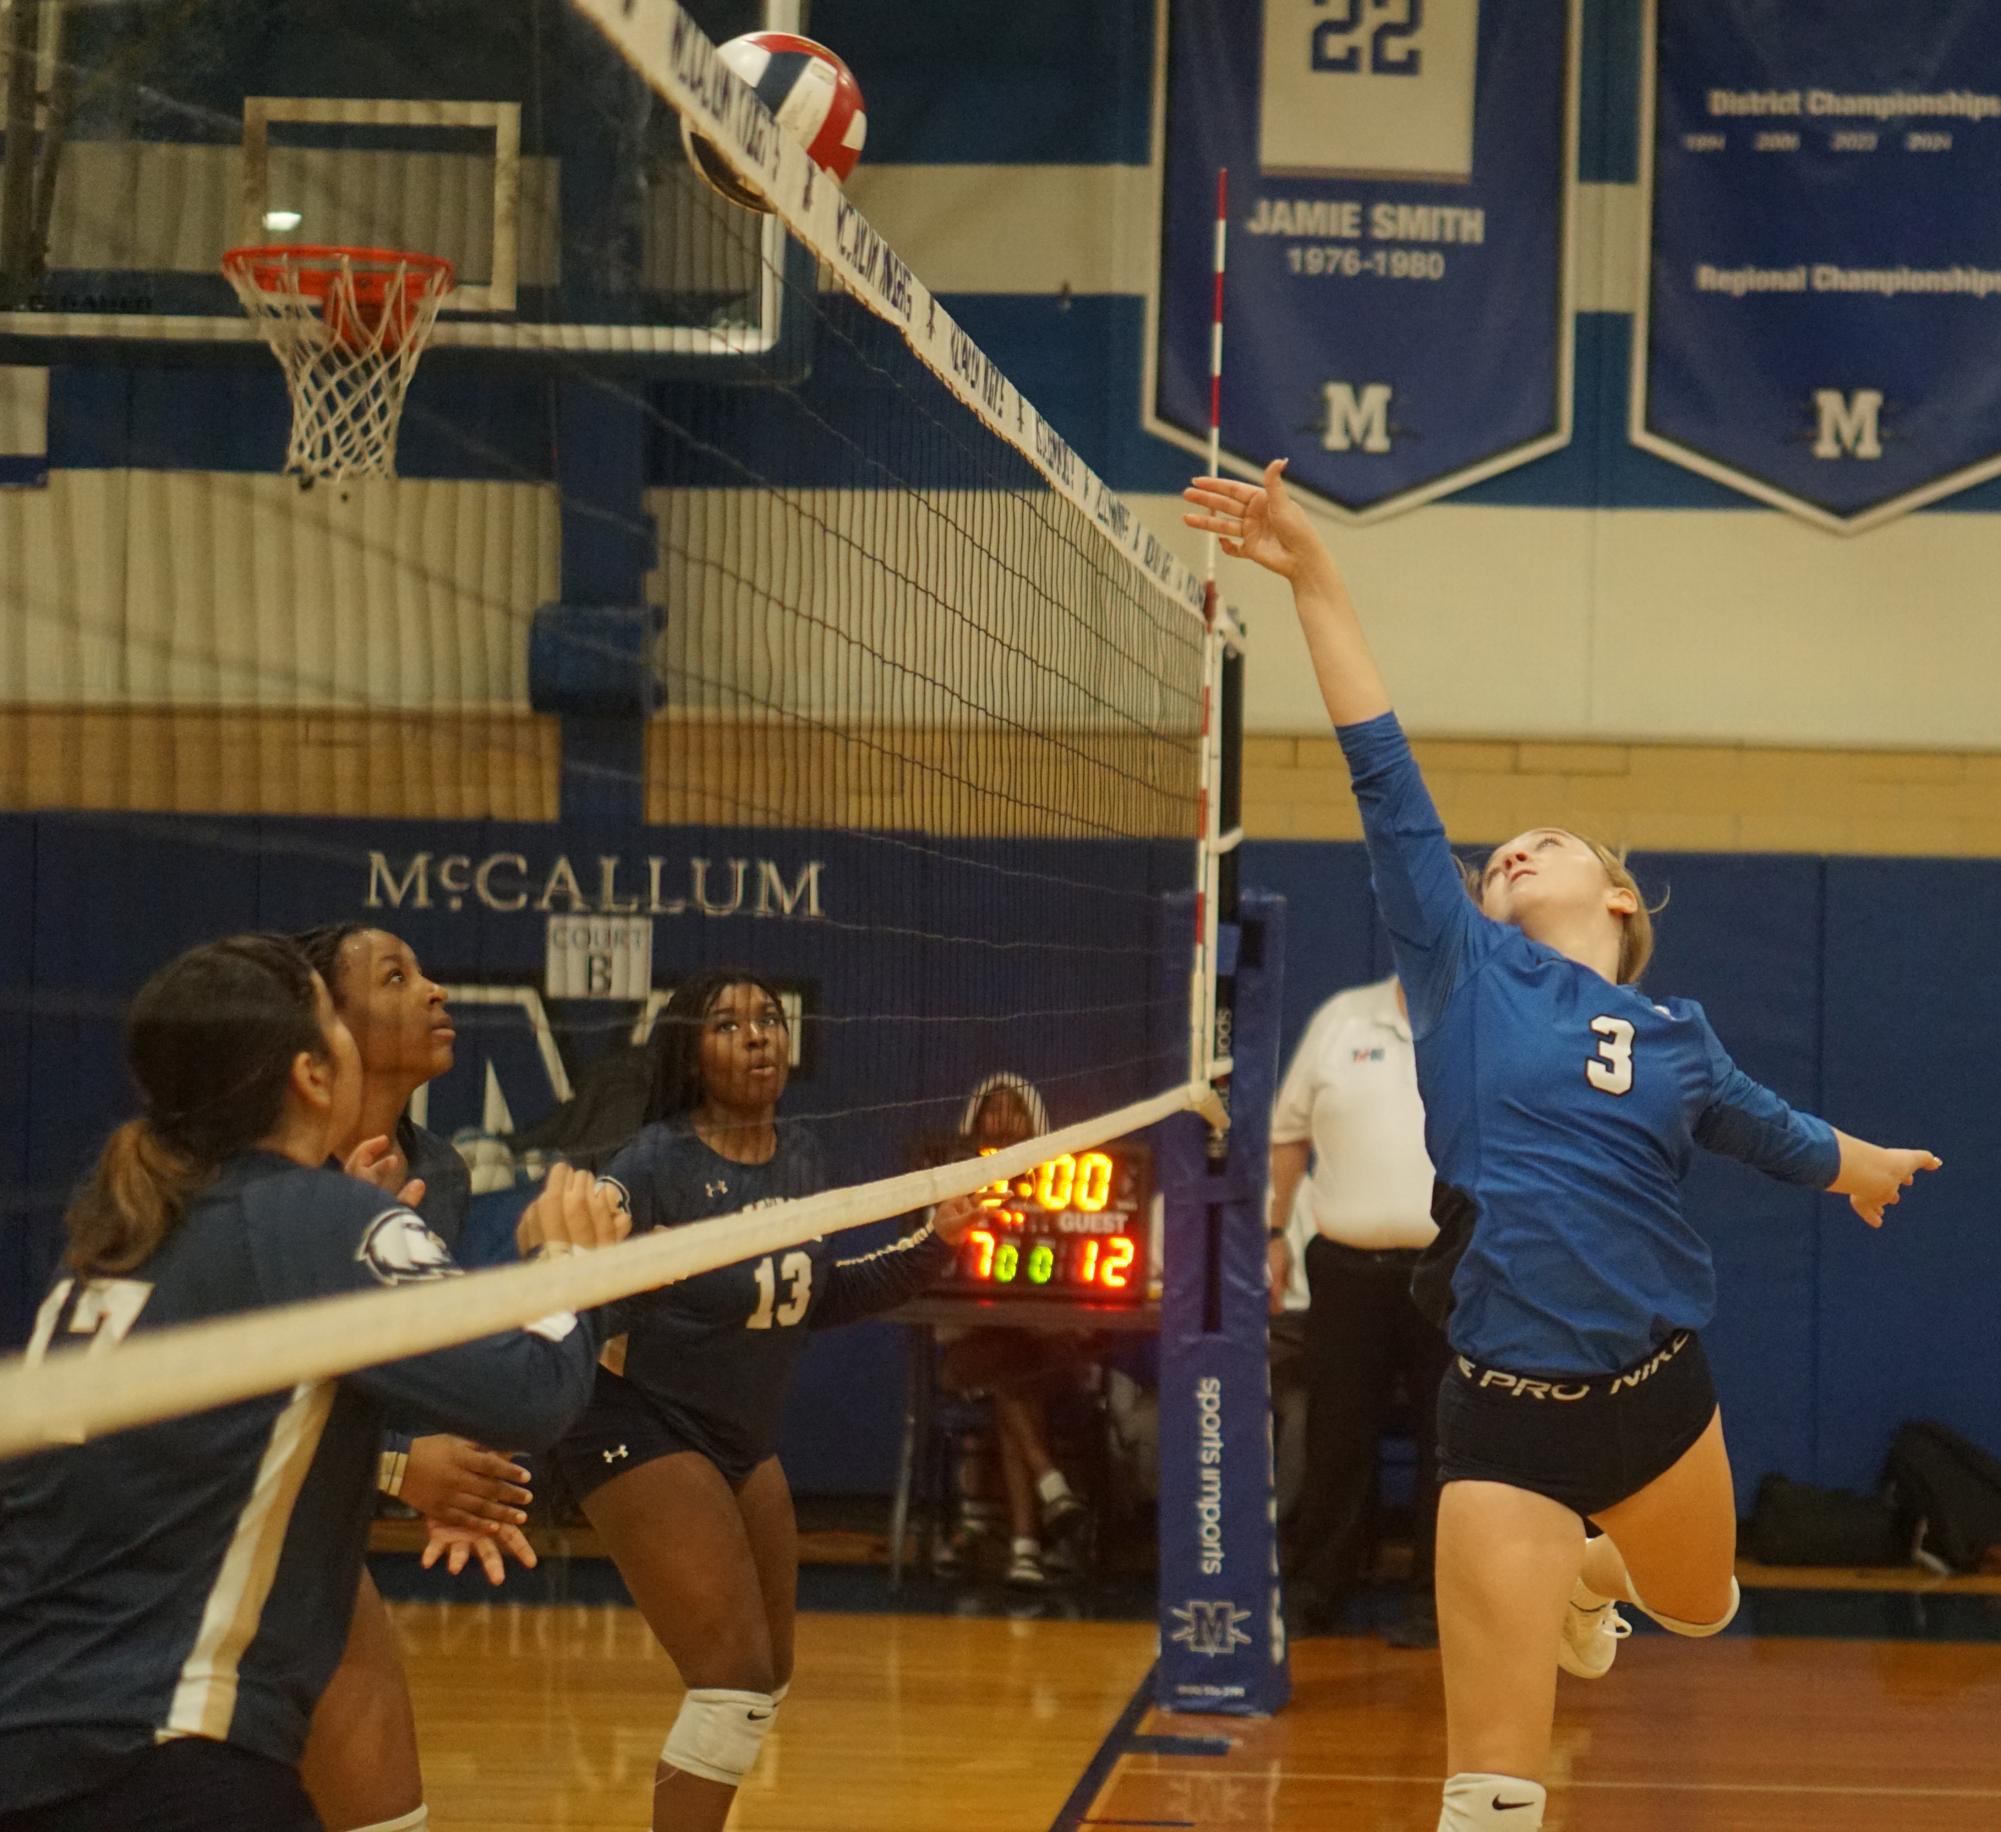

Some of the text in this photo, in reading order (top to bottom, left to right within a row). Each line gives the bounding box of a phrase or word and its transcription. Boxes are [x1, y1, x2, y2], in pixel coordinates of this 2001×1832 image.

[1312, 0, 1423, 76] 22
[1247, 200, 1486, 243] JAMIE SMITH
[1286, 247, 1444, 279] 1976-1980
[1696, 264, 1806, 297] Regional
[1323, 382, 1393, 452] M
[1811, 389, 1883, 459] M
[550, 926, 644, 951] COURT
[1585, 1015, 1637, 1097] 3
[1057, 1213, 1128, 1233] GUEST
[1079, 1236, 1134, 1288] 12
[745, 1250, 813, 1329] 13
[1478, 1370, 1590, 1401] PRO
[1196, 1377, 1224, 1575] sports imports
